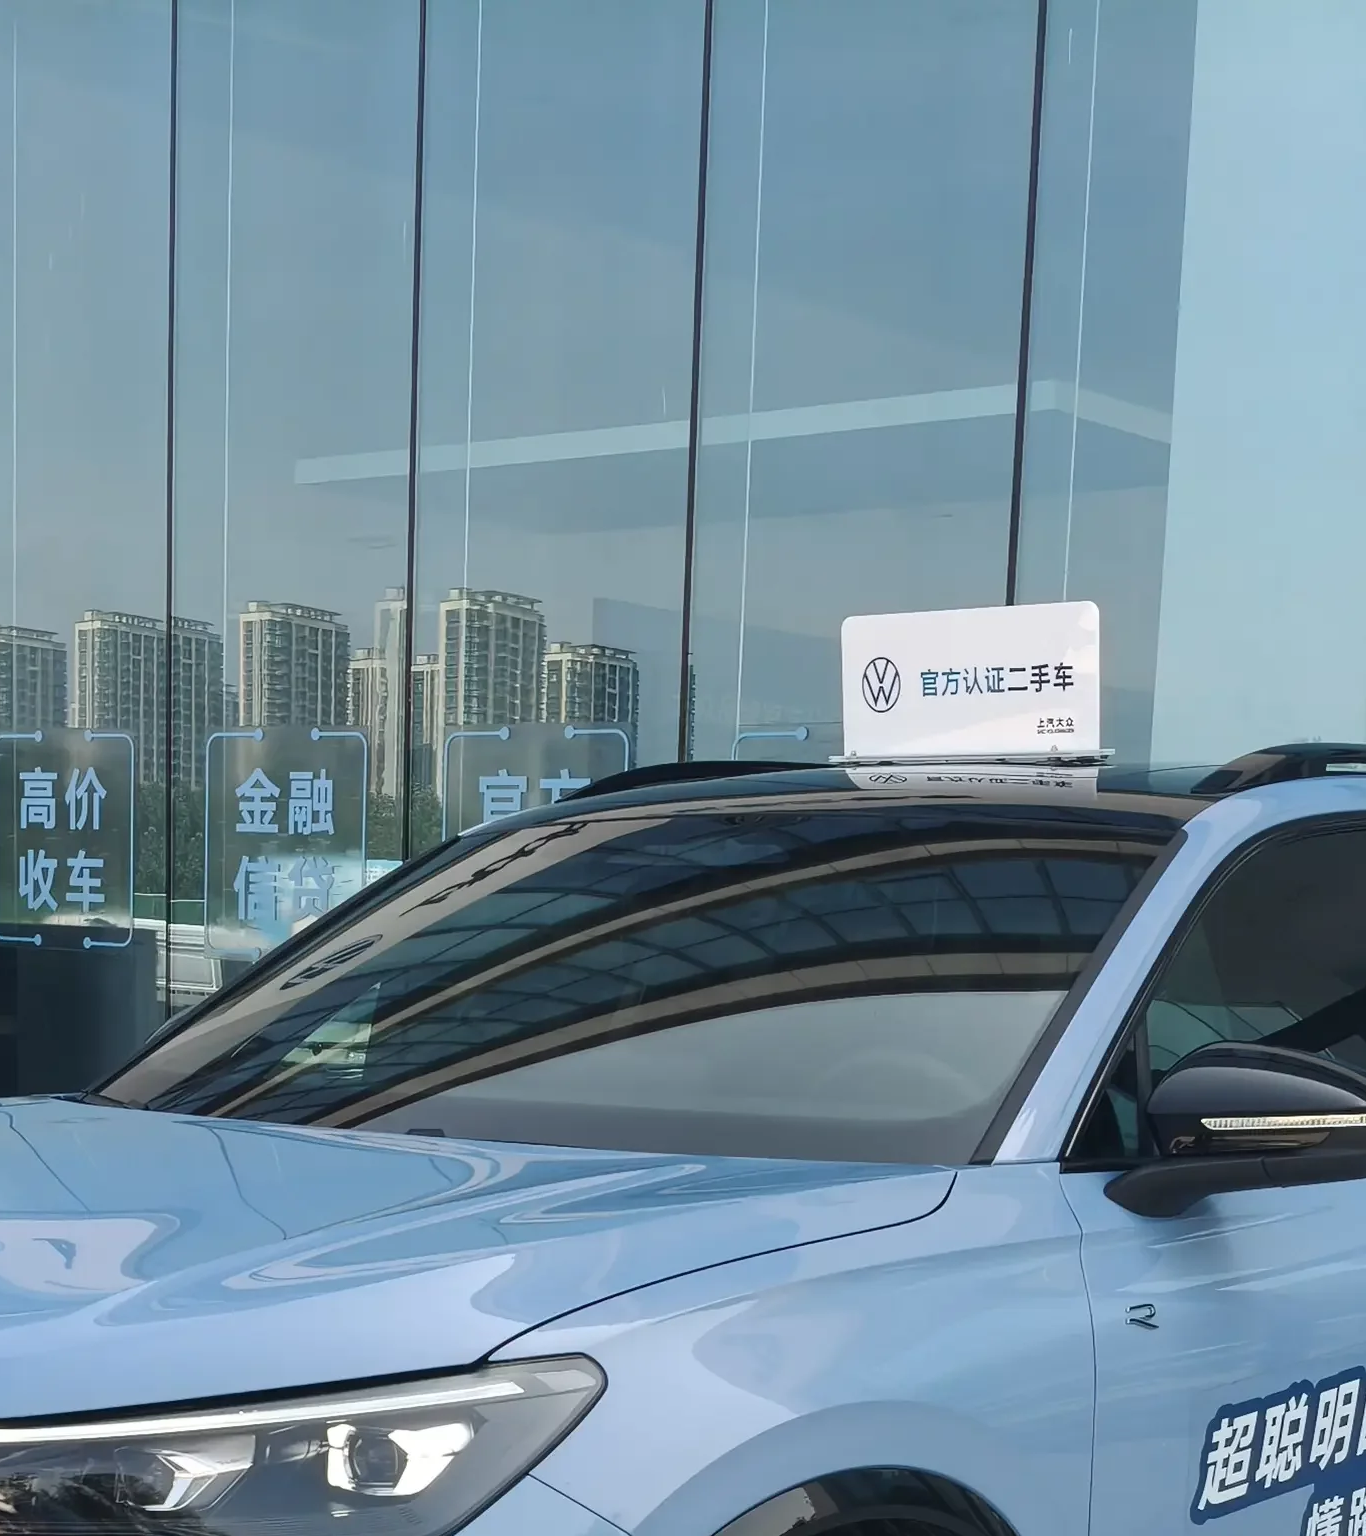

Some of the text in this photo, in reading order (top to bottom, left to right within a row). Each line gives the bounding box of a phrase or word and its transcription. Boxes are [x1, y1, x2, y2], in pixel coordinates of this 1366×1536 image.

[920, 662, 1075, 697] 官方认证二手车
[1037, 717, 1075, 728] 上汽大众
[19, 767, 107, 832] 高价
[235, 767, 335, 836] 金融
[17, 850, 106, 912] 收车
[234, 855, 335, 921] 信贷
